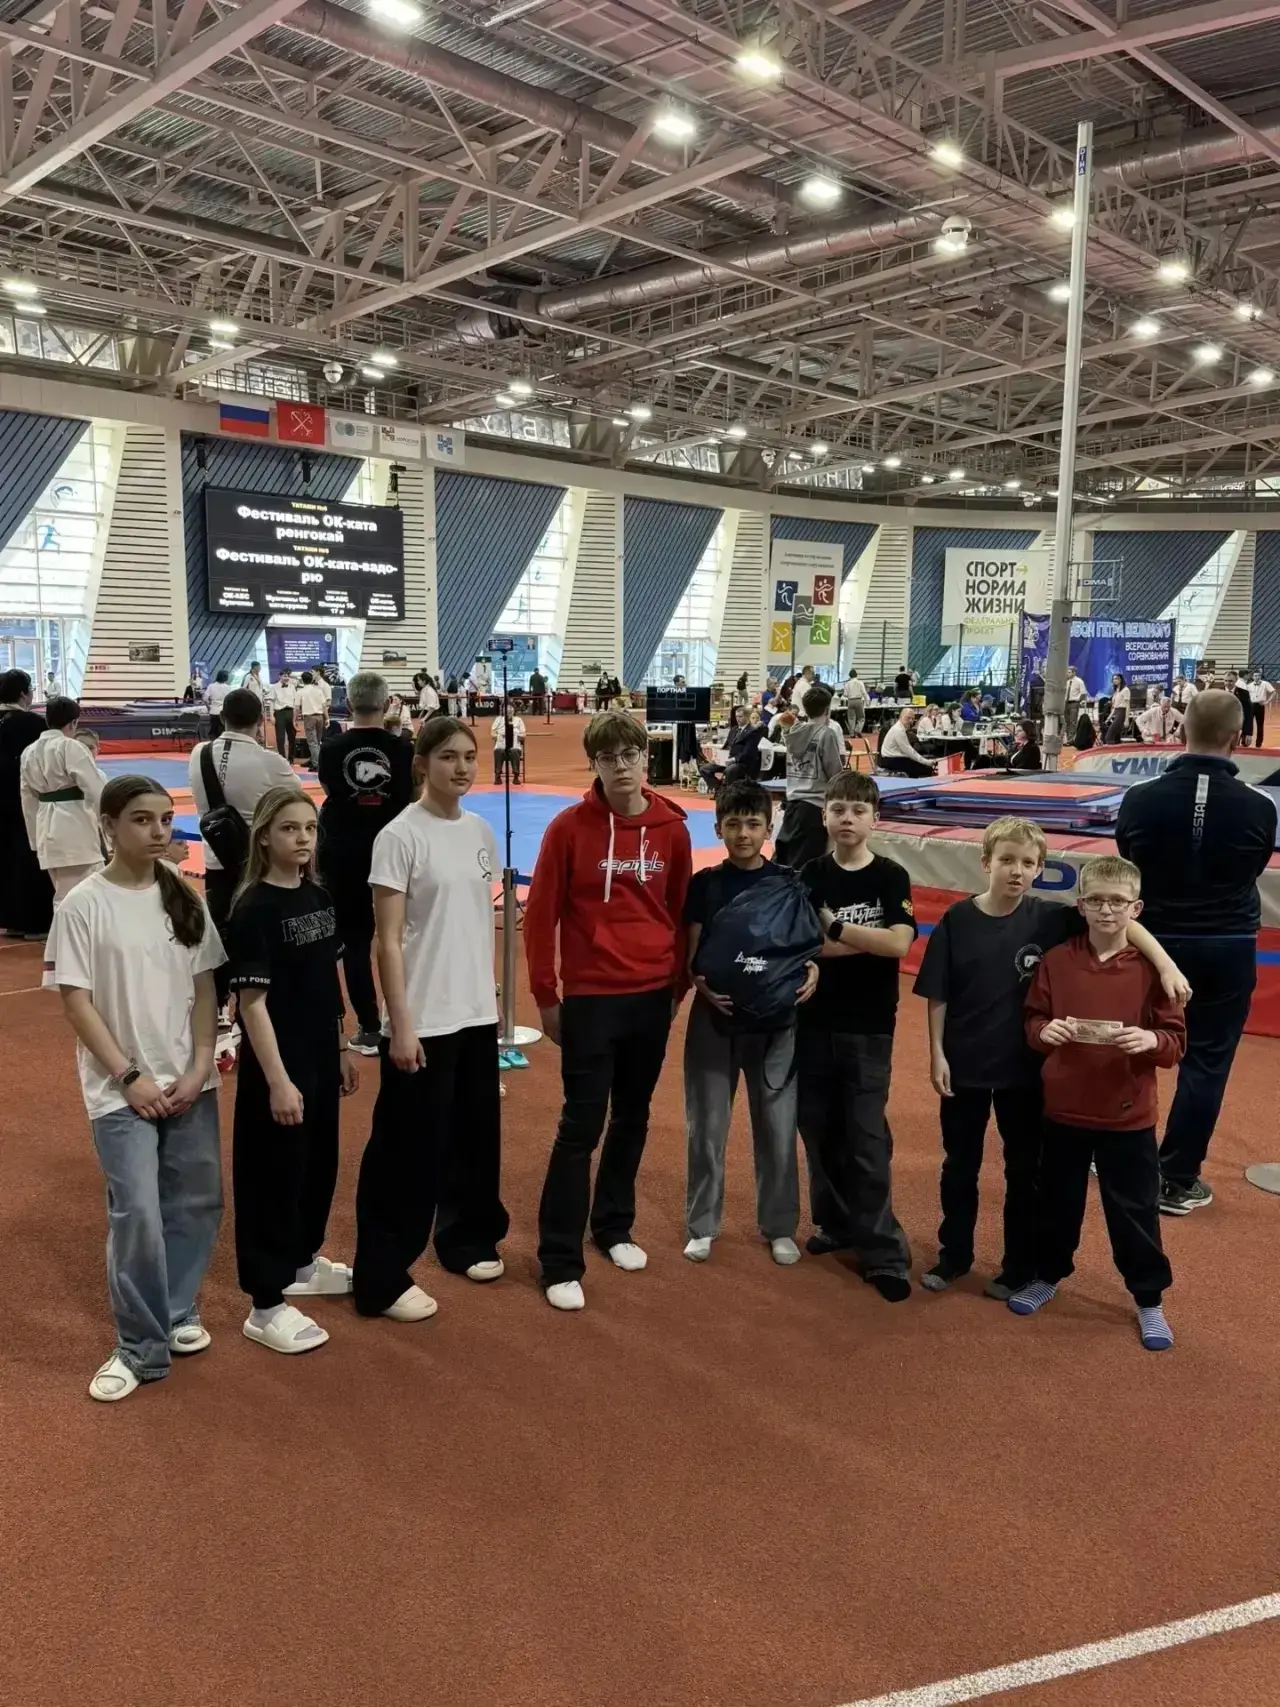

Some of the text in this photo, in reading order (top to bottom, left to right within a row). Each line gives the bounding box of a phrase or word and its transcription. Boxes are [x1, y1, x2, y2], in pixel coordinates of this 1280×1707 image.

[236, 505, 378, 531] Фестиваль ОК-ката
[275, 526, 344, 543] ренгокай
[215, 547, 398, 575] Фестиваль ОК-ката-вадо-
[966, 561, 1017, 577] СПОРТ
[301, 572, 324, 585] рю
[965, 579, 1026, 596] НОРМА
[965, 597, 1025, 613] ЖИЗНИ
[964, 626, 996, 635] ПРОЕКТ
[1096, 621, 1124, 638] ПЕТРА
[1125, 621, 1171, 638] ВЕЛИКОГО
[475, 701, 495, 709] KAIDO
